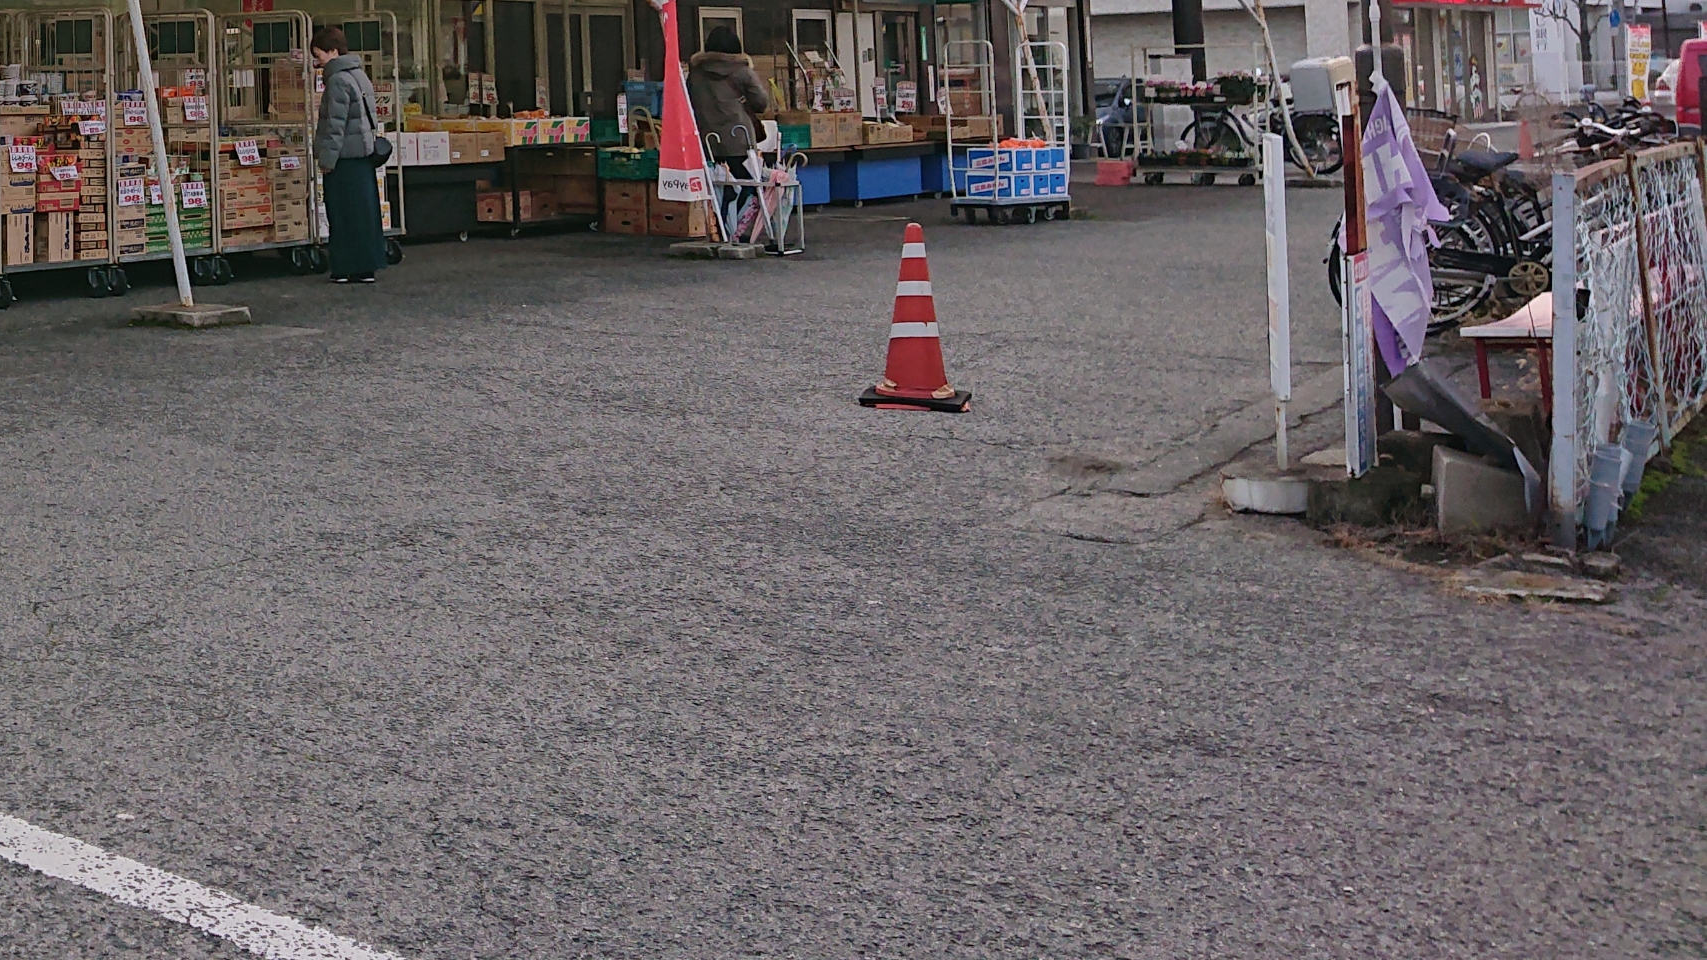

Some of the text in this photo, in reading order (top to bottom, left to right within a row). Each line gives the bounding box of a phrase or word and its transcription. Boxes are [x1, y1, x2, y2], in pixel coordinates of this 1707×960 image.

[241, 154, 256, 162] 98
[16, 162, 33, 170] 98
[124, 194, 141, 203] 98
